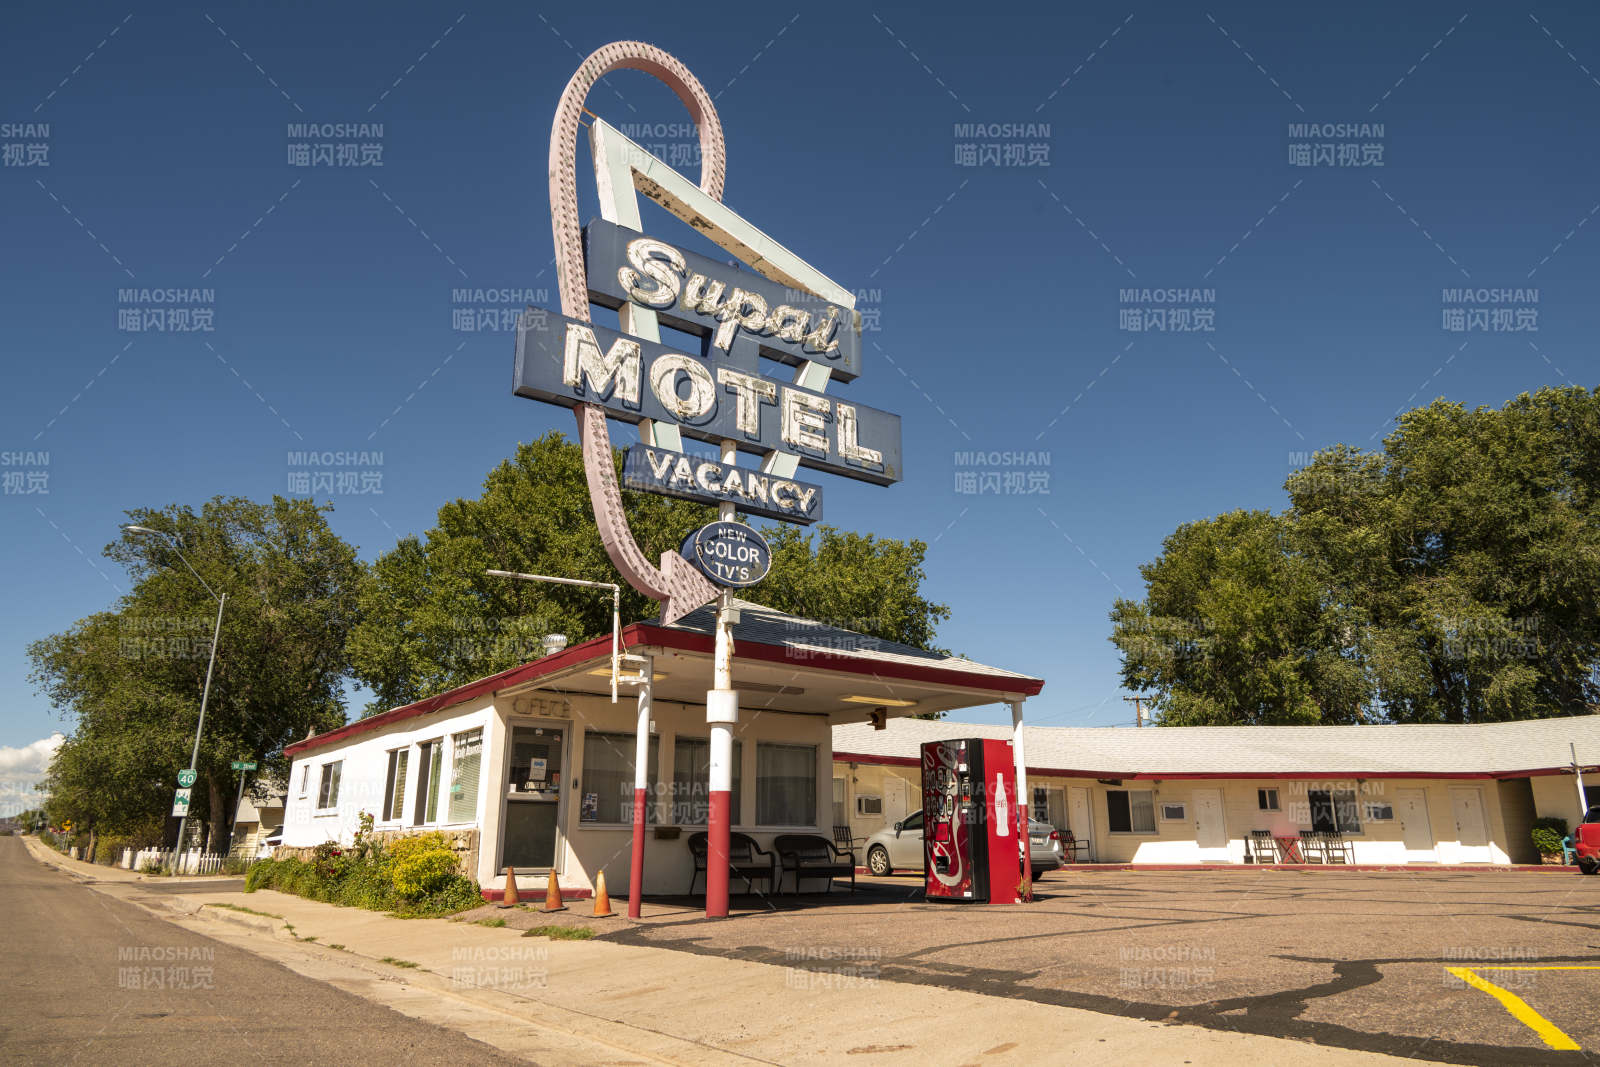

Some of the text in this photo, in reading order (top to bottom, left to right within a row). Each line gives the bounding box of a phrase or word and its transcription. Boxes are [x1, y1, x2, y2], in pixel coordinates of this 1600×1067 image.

[618, 236, 841, 354] Supai
[562, 322, 884, 465] MOTEL
[645, 448, 816, 515] VACANCY
[718, 528, 747, 542] NEW
[704, 540, 760, 563] COLOR
[714, 561, 750, 580] TV'S
[180, 775, 194, 784] 40
